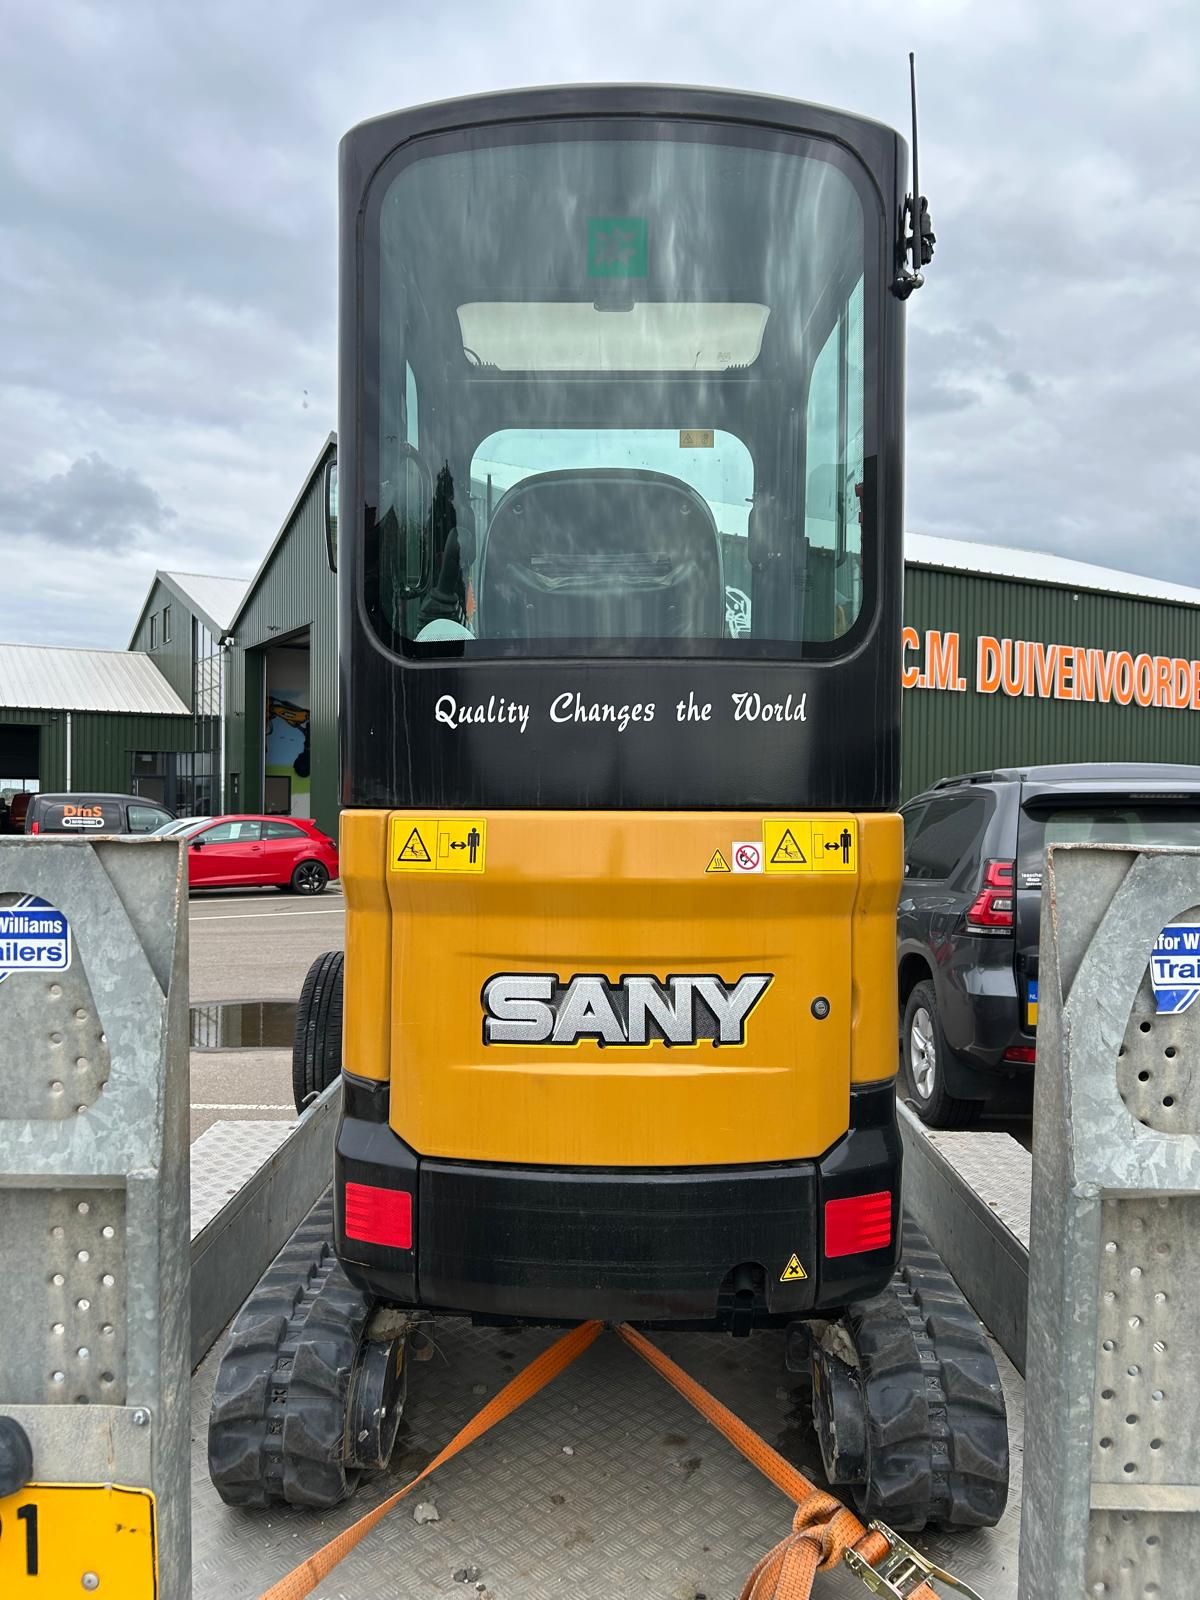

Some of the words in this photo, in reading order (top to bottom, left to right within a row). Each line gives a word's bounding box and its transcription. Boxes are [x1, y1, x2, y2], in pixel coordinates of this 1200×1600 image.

[902, 626, 968, 693] C.M.
[434, 694, 530, 734] Quality
[549, 692, 656, 733] Changes
[676, 691, 712, 723] the
[732, 691, 808, 723] World
[481, 971, 776, 1048] SANY
